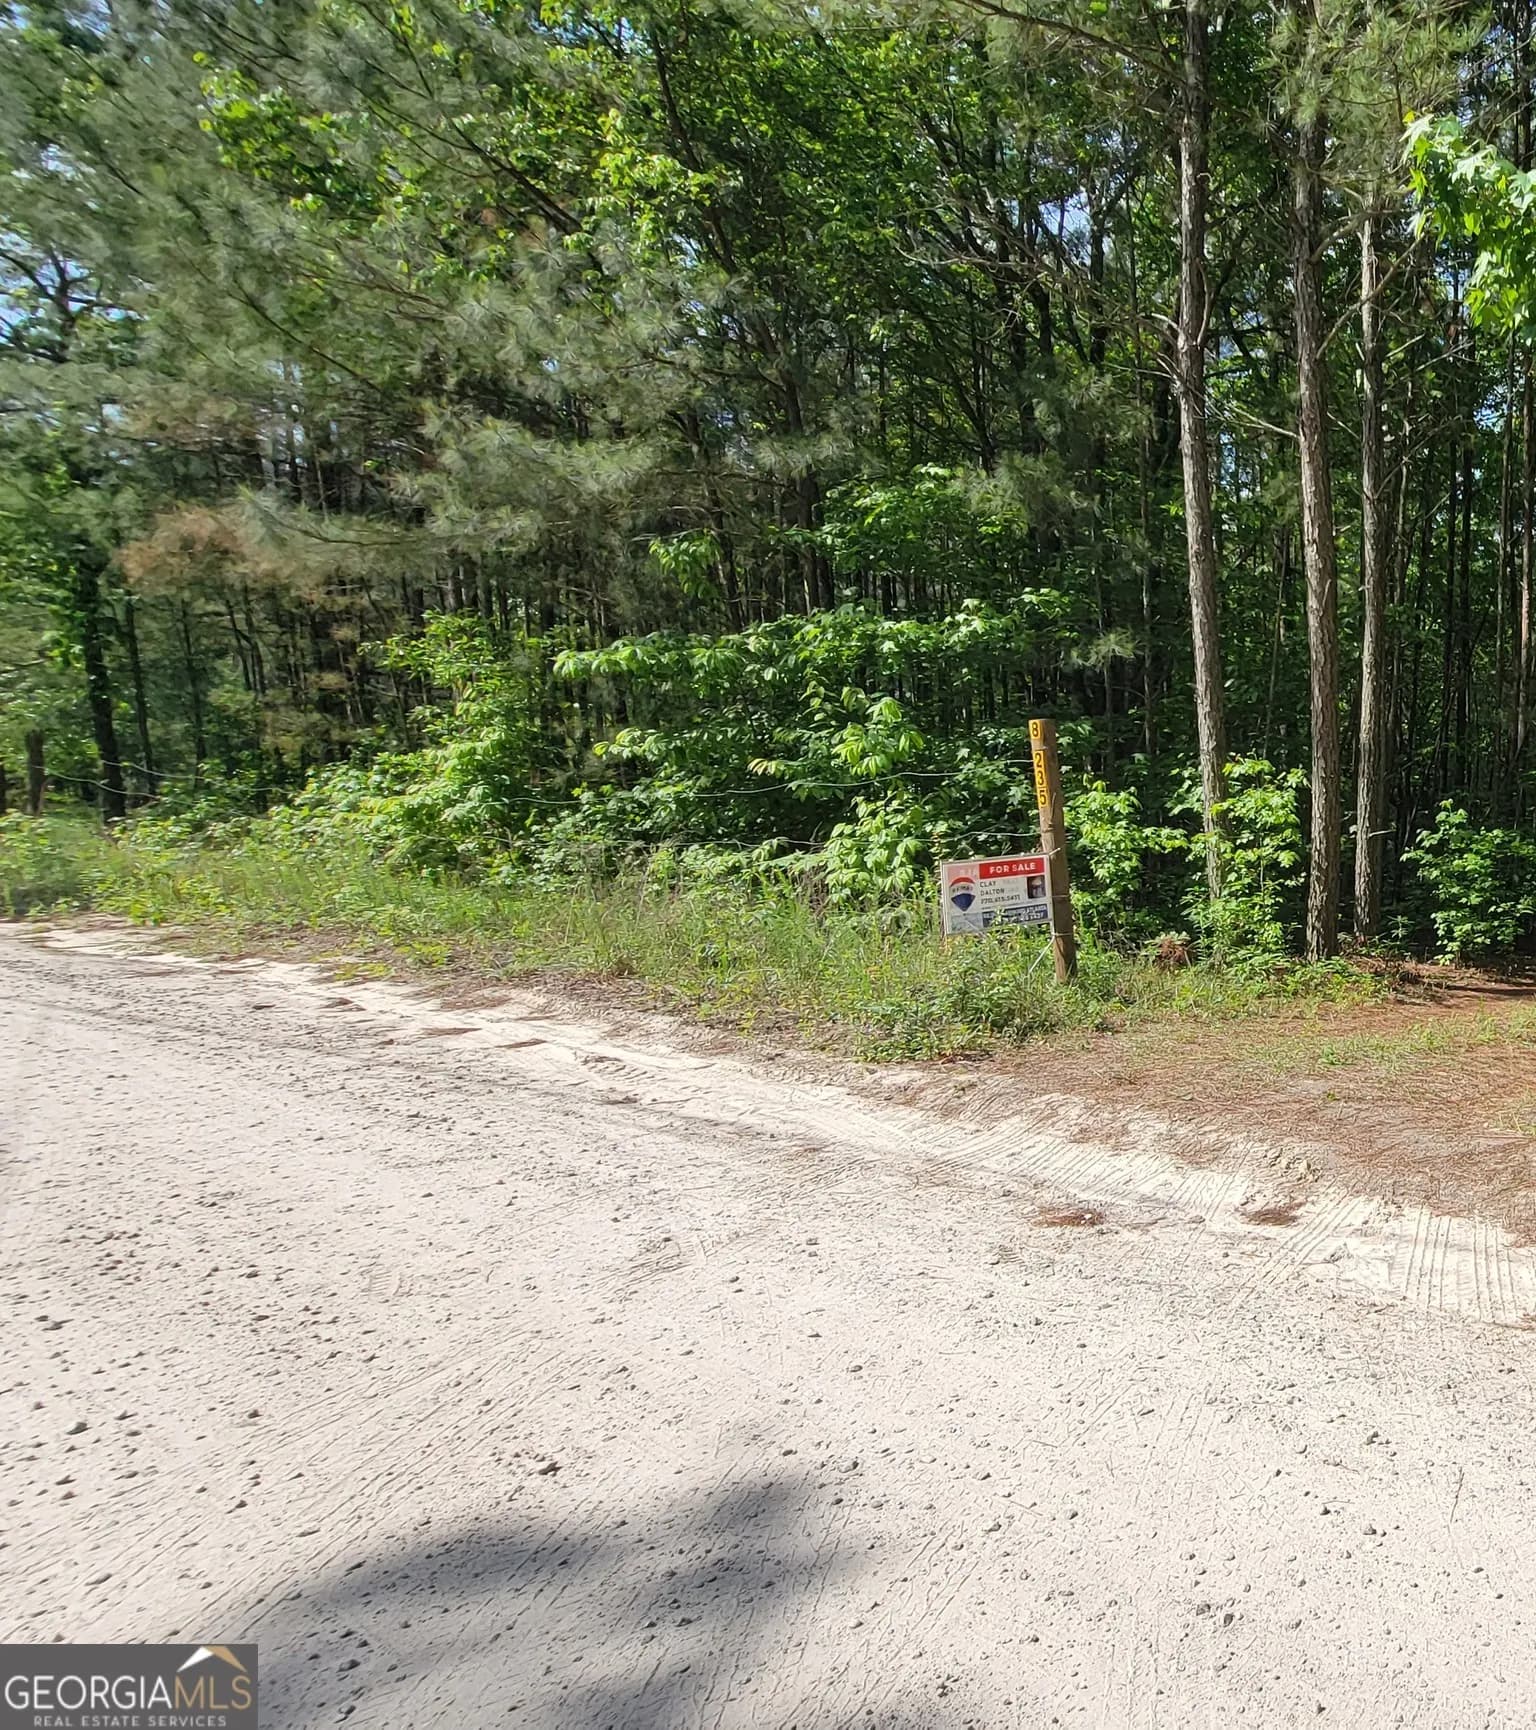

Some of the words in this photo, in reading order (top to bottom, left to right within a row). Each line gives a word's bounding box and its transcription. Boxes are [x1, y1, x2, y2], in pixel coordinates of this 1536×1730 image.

[989, 865, 1010, 874] FOR
[1012, 862, 1036, 872] SALE
[980, 880, 996, 888] CLAY
[980, 888, 1005, 896] DALTON
